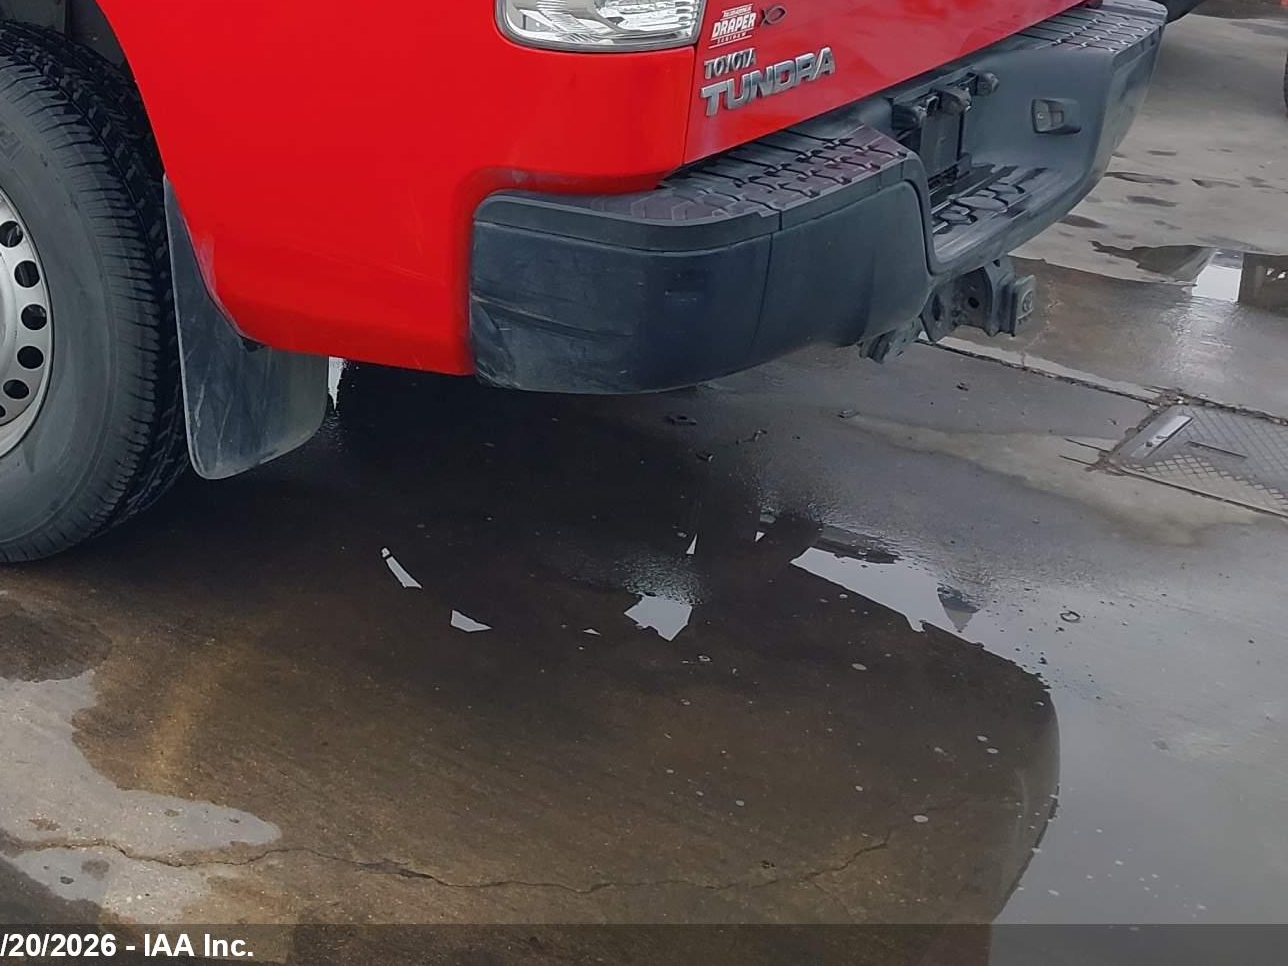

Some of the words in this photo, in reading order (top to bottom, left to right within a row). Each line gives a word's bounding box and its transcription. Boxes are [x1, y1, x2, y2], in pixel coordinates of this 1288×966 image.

[712, 13, 756, 37] DRAPER
[704, 47, 756, 79] TOYOTA
[700, 46, 836, 117] TUNDRA
